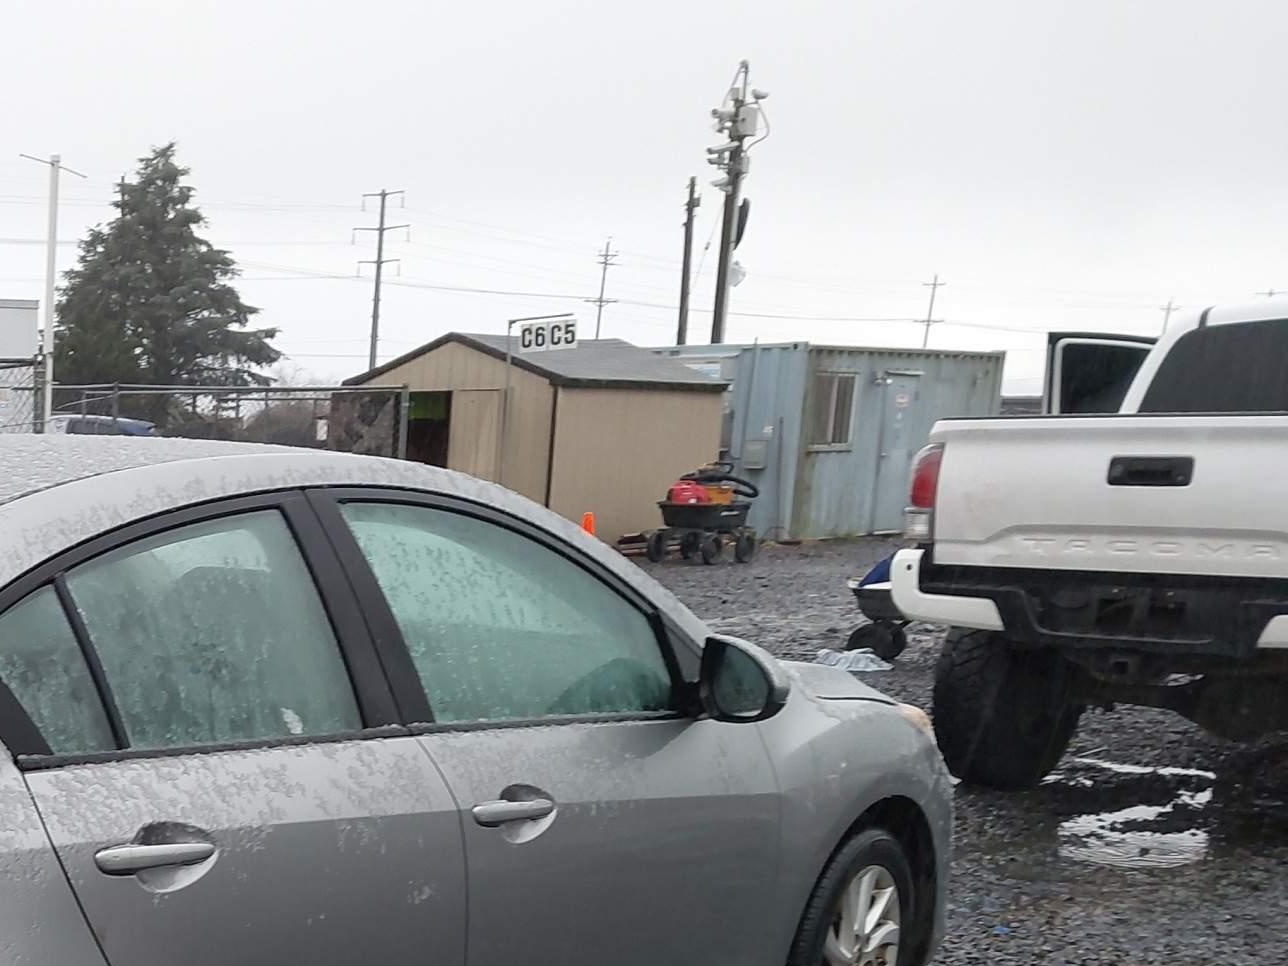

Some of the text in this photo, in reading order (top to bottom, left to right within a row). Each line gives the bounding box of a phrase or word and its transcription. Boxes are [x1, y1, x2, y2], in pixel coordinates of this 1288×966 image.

[521, 323, 576, 349] C6 C5
[1020, 536, 1282, 561] TACOMA
